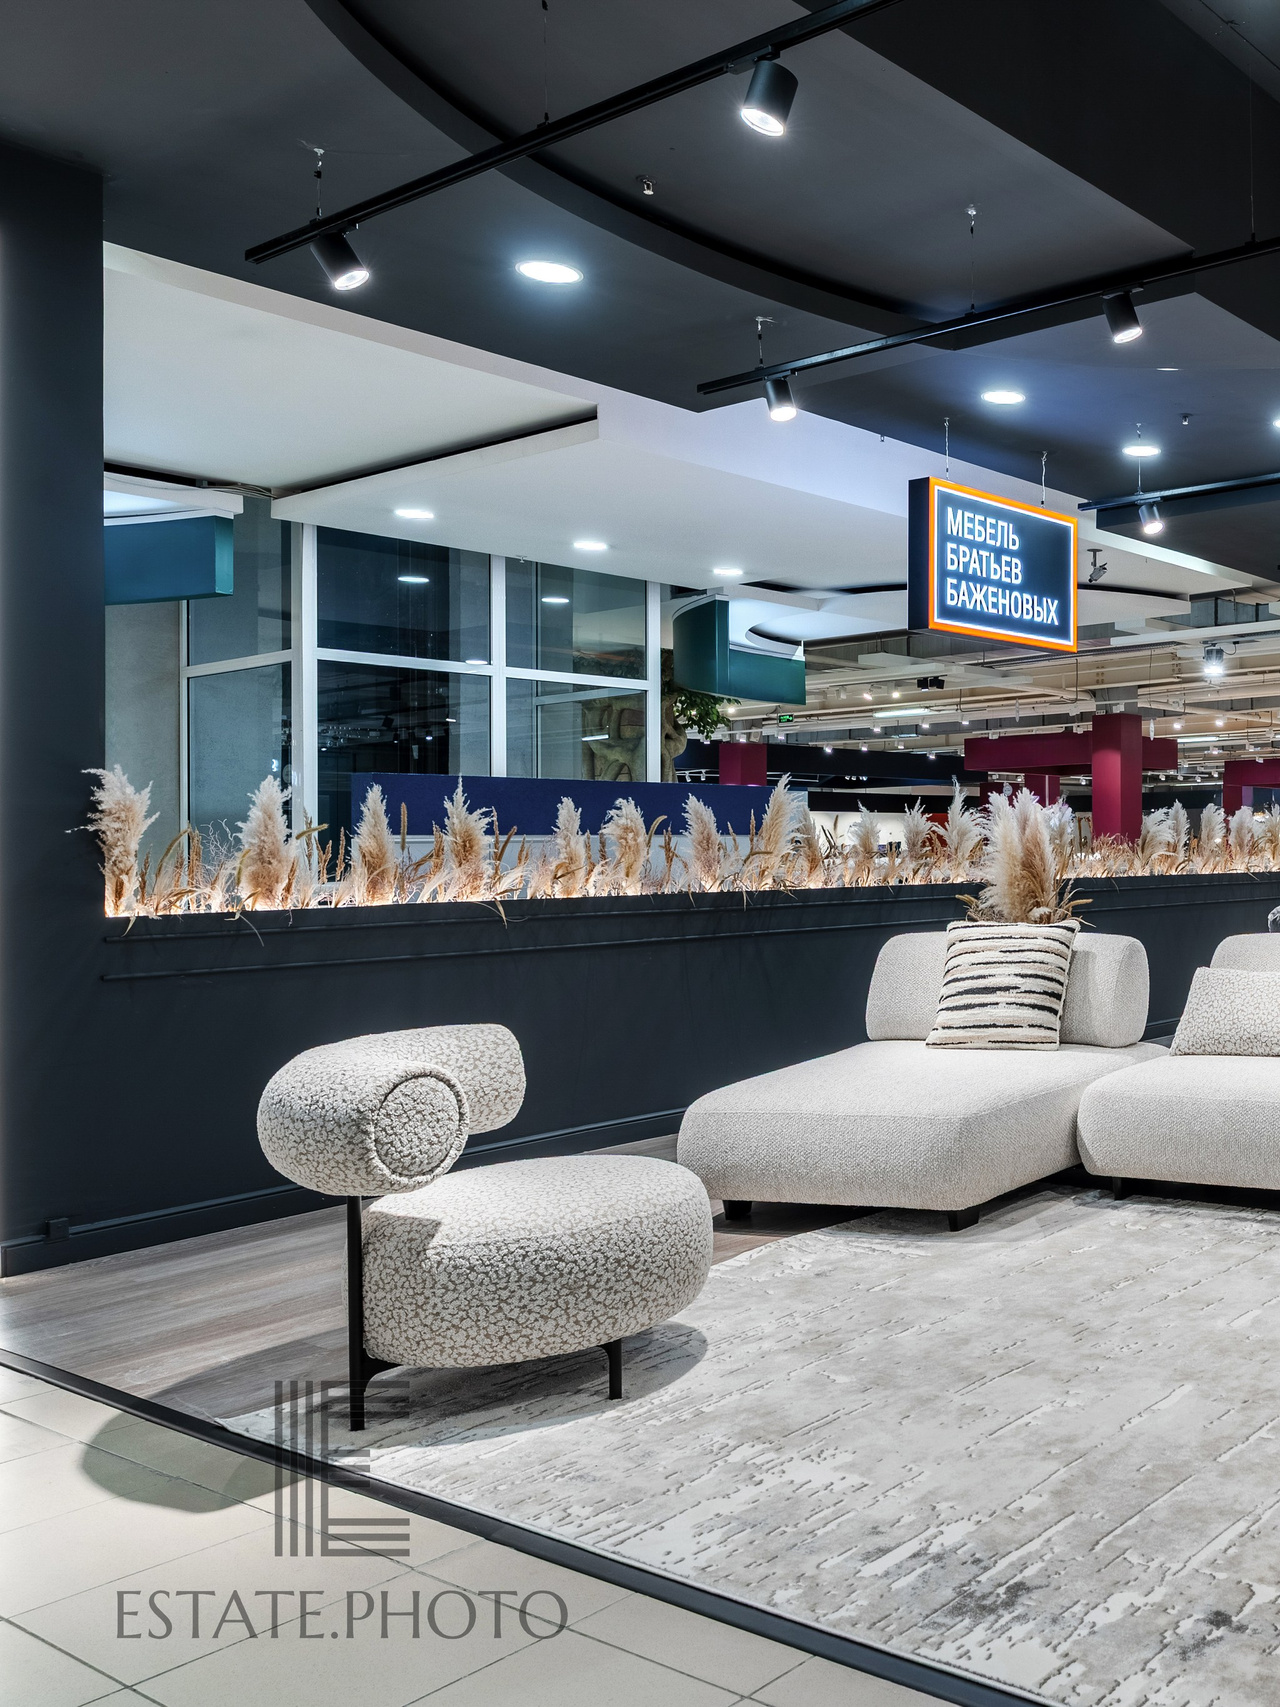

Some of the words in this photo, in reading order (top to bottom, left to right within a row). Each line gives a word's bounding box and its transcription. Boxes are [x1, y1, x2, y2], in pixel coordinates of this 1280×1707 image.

[947, 507, 1020, 550] МЕБЕЛЬ
[947, 541, 1022, 584] БРАТЬЕВ
[947, 577, 1059, 625] БАЖЕНОВЫХ
